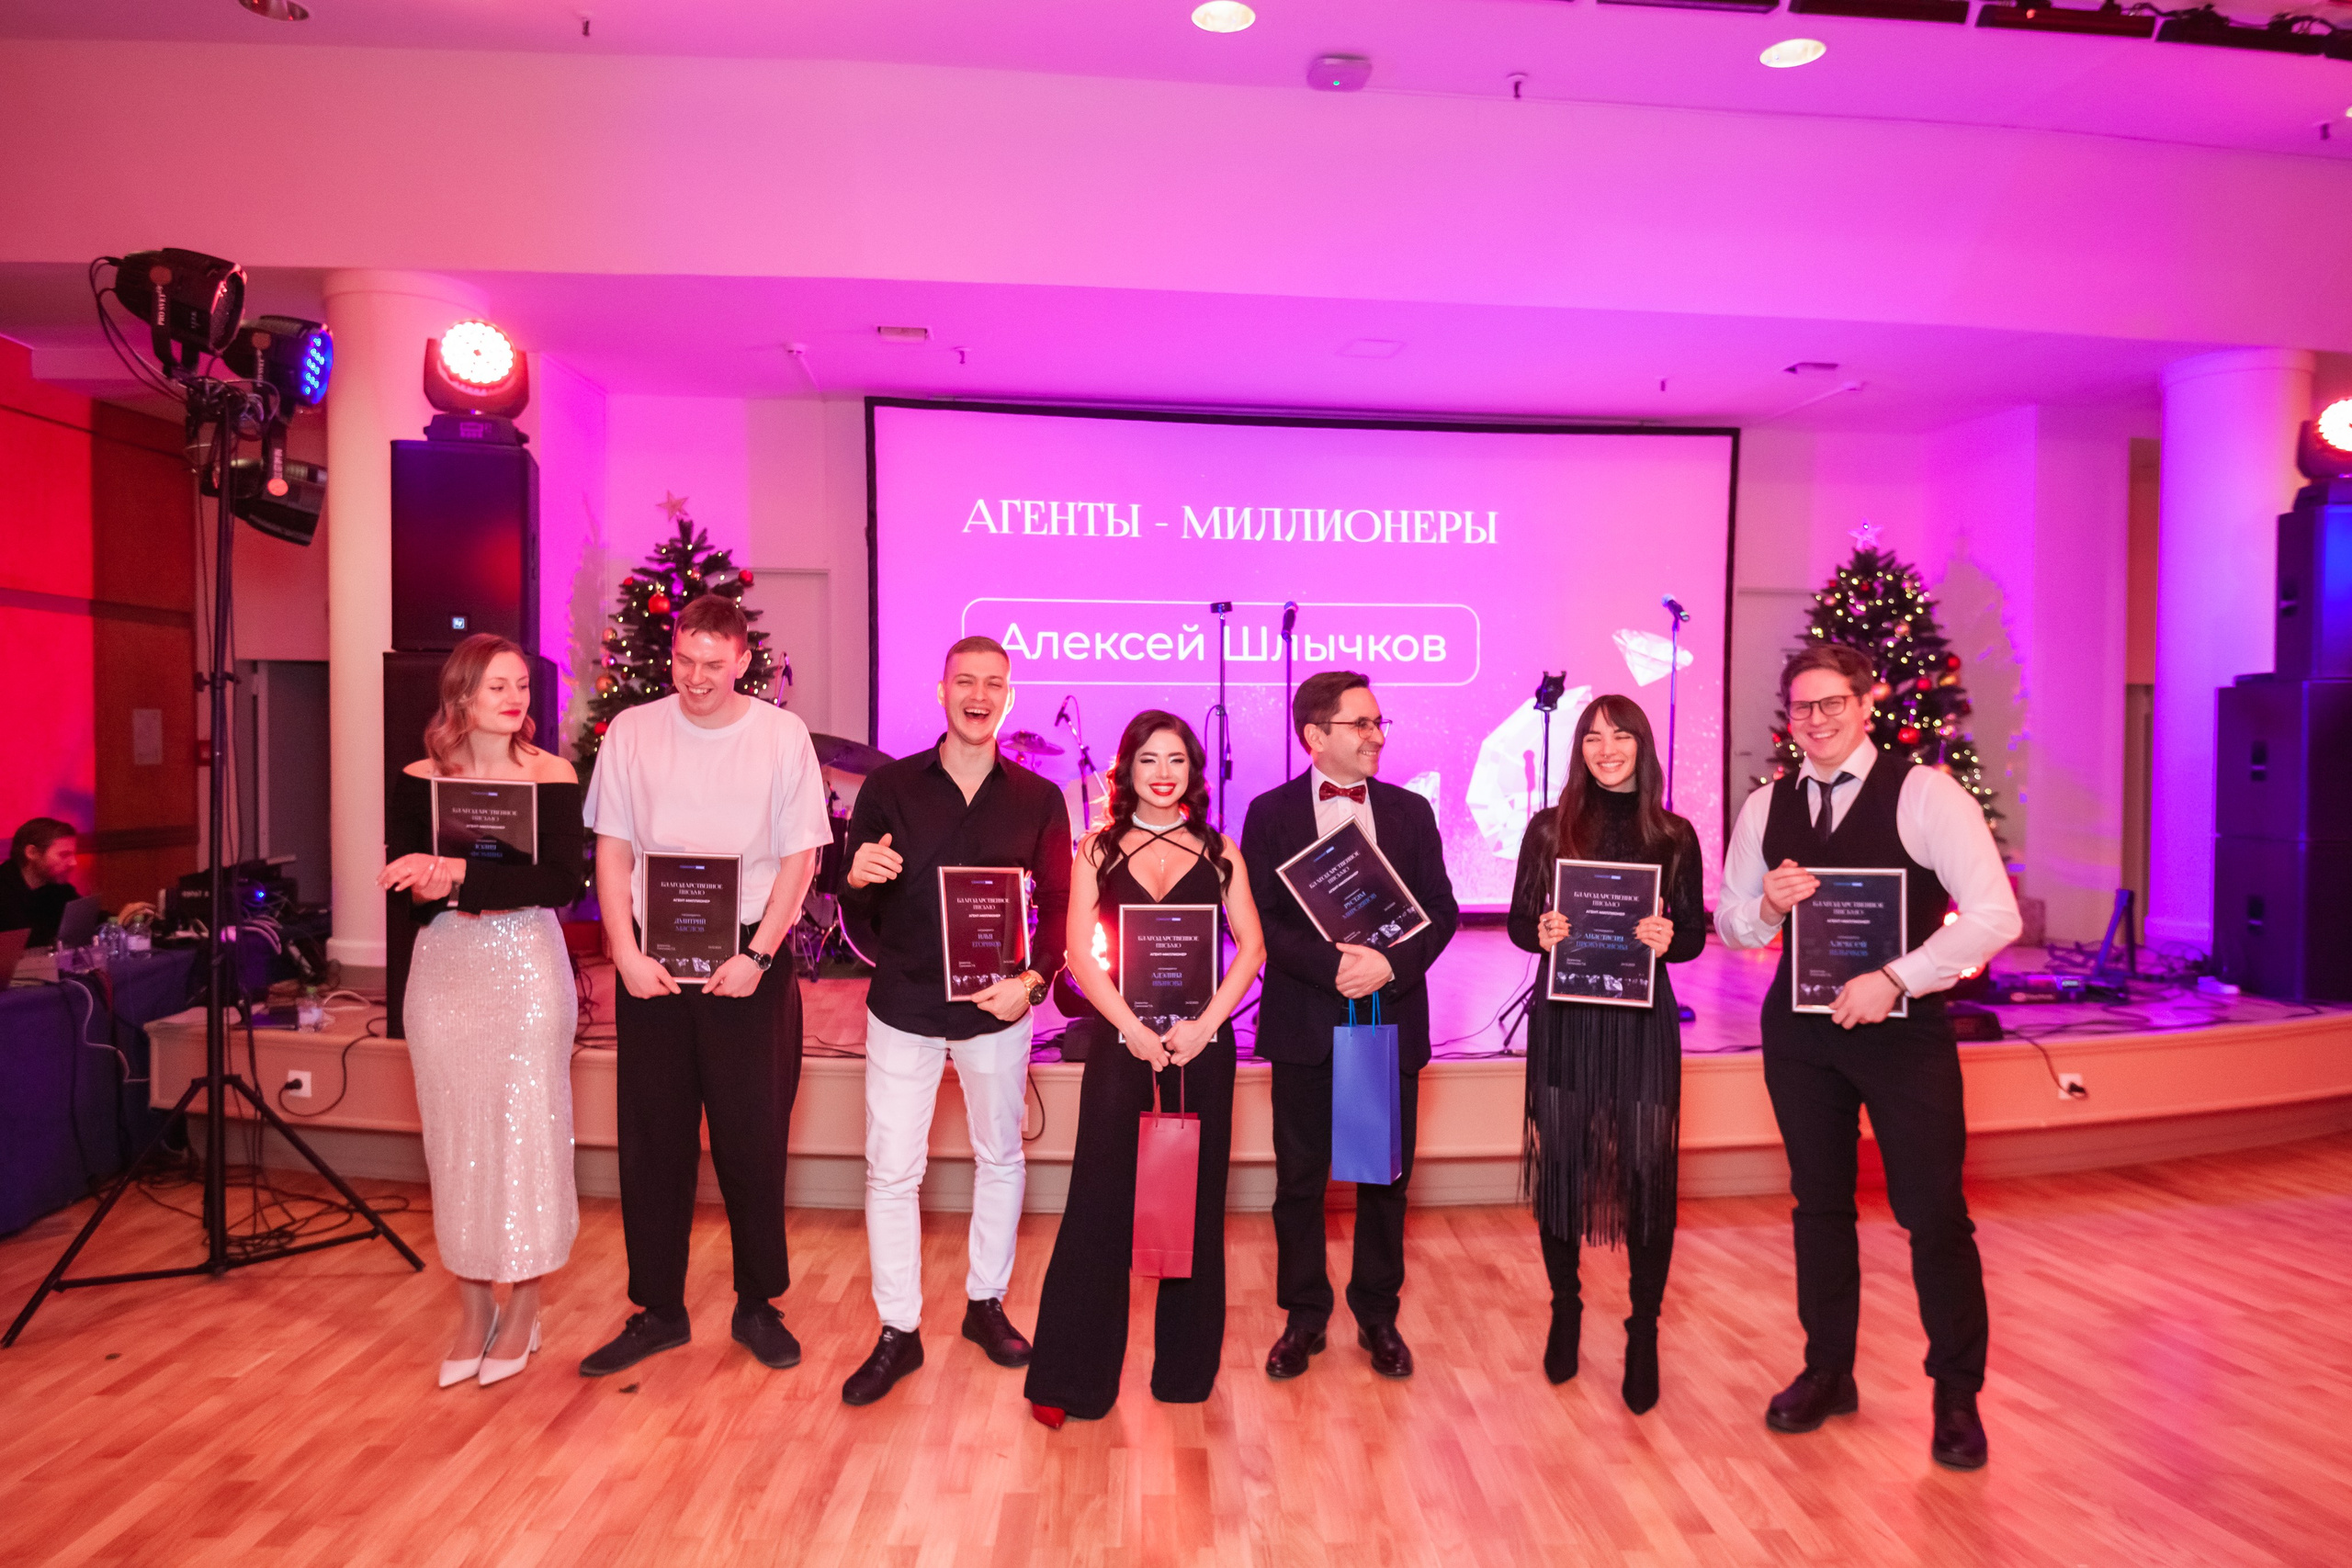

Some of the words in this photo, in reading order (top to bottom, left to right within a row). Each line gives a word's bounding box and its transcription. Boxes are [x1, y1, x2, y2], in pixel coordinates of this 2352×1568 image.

[962, 499, 1142, 538] АГЕНТЫ
[1181, 505, 1499, 545] МИЛЛИОНЕРЫ
[1001, 622, 1204, 661] Алексей
[1224, 626, 1447, 662] Шлычков
